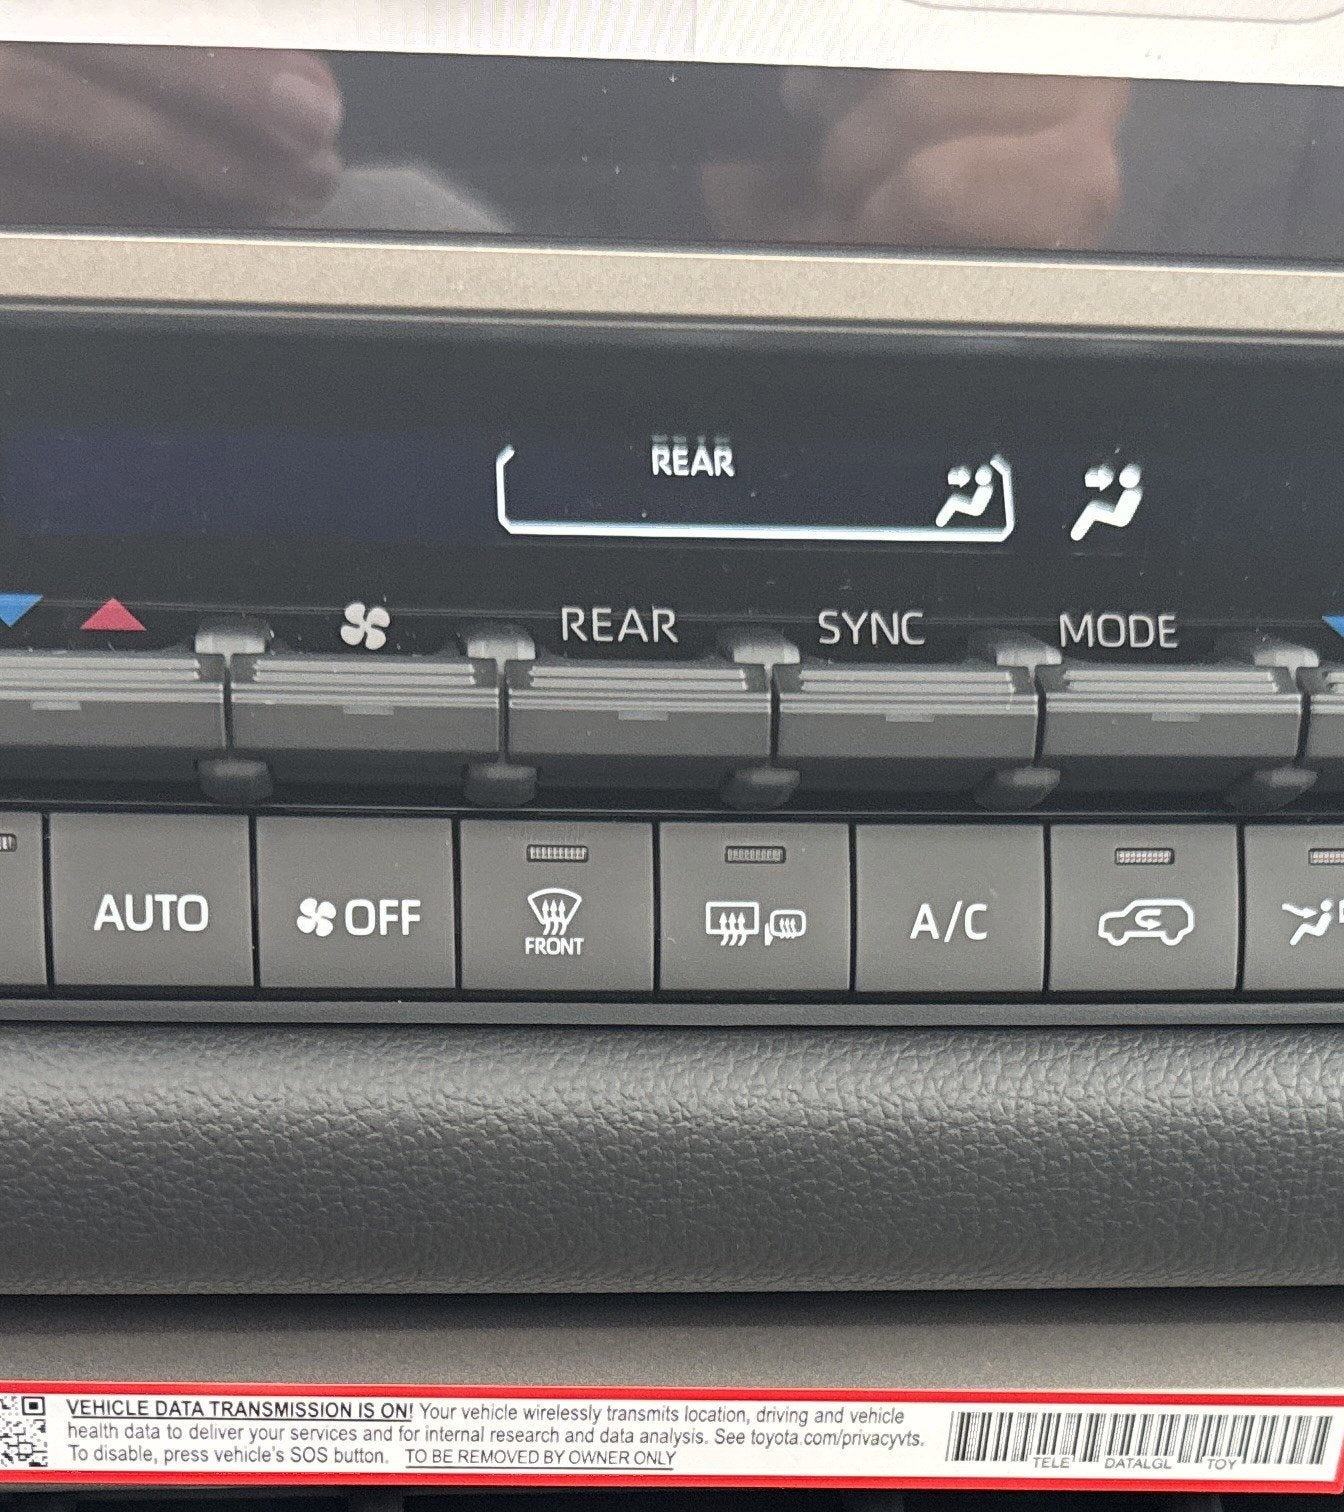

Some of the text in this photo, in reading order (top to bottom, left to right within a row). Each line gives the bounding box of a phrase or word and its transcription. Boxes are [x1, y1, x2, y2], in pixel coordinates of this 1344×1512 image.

[651, 440, 735, 478] REAR
[560, 606, 679, 644] REAR
[818, 610, 926, 647] SYNC
[1059, 612, 1180, 649] MODE
[92, 893, 210, 932] AUTO
[344, 897, 422, 936] OFF
[909, 901, 989, 943] A/C
[524, 936, 585, 956] FRONT
[66, 1399, 904, 1428] VEHICLE DATA TRANSMISSION IS ON! Your vehicle wirelessly transmits location, driving and vehicle
[68, 1421, 925, 1452] health data to deliver your services and for internal research and data analysis. See toyota.com/privacyvts.
[68, 1444, 677, 1466] To disable, press vehicle's SOS button. TO BE REMOVED BY OWNER ONLY
[1033, 1456, 1070, 1469] TELE
[1207, 1458, 1237, 1471] TOY
